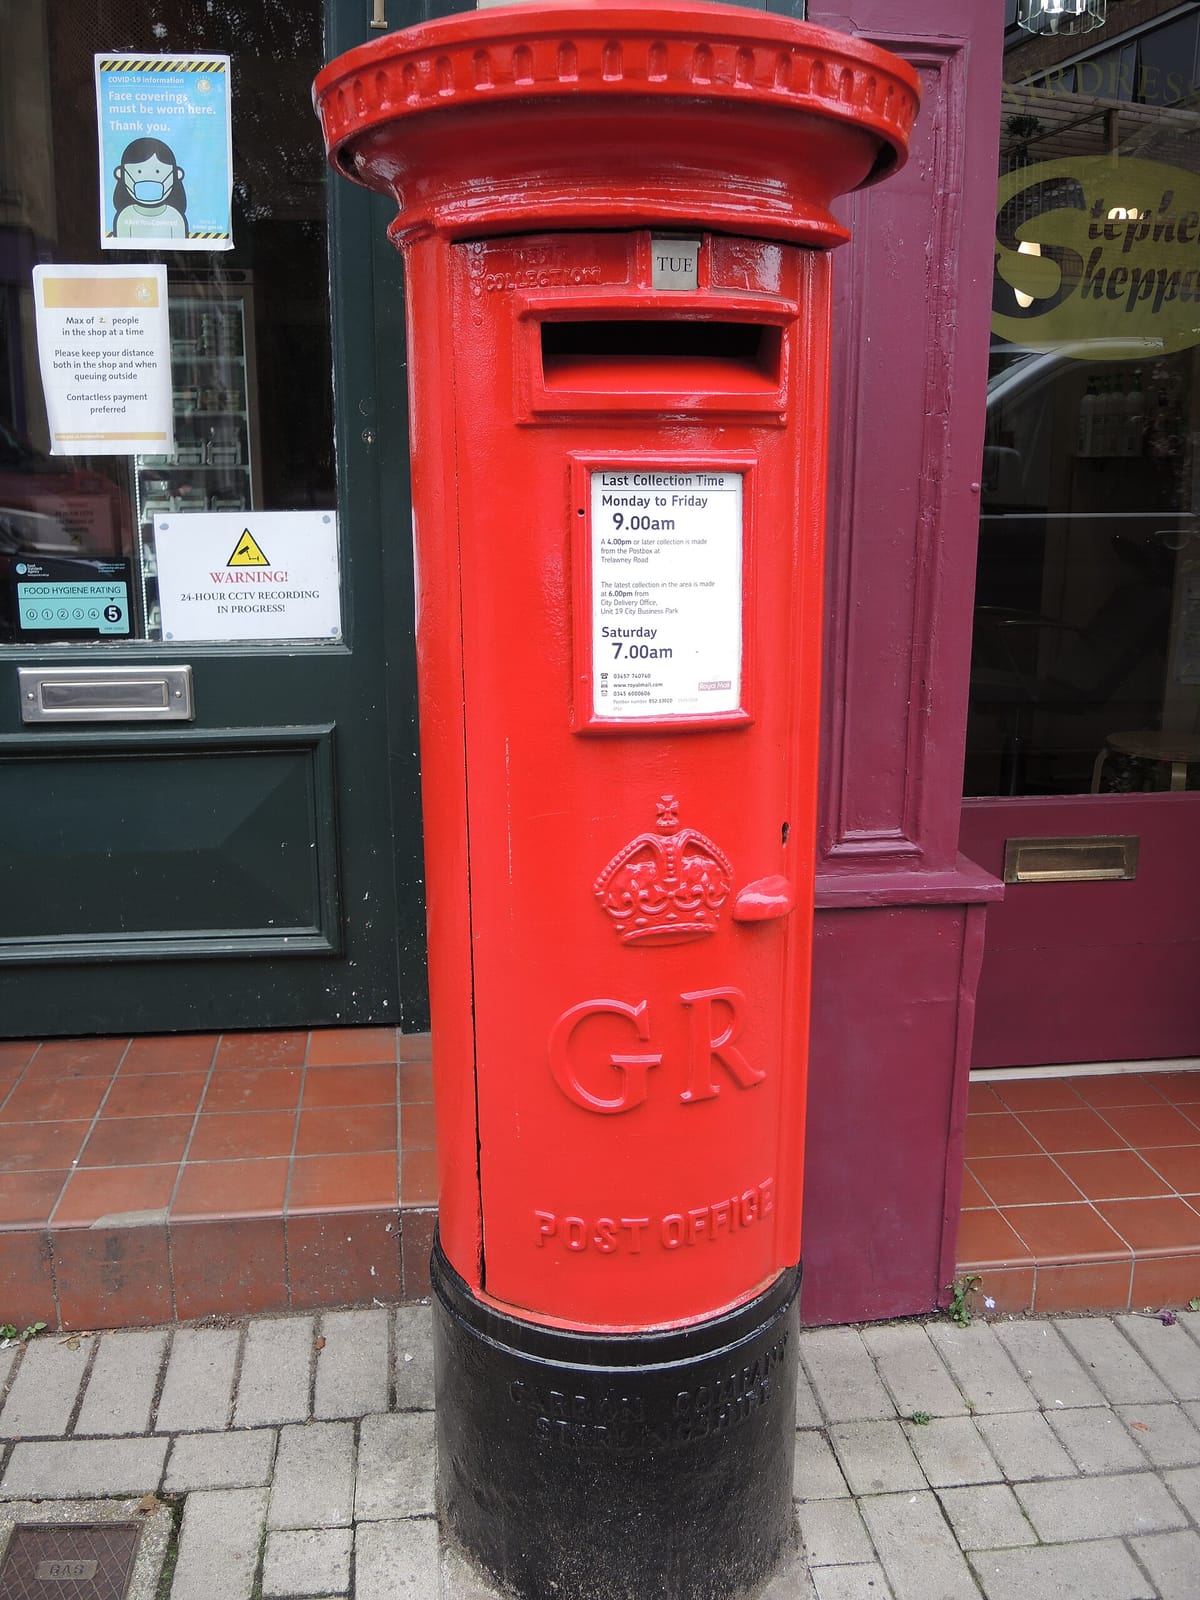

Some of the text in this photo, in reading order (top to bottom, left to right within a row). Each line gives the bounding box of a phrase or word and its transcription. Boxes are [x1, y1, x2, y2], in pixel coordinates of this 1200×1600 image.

[108, 76, 141, 84] COVID-19
[109, 91, 188, 104] Face coverings
[109, 104, 216, 115] must be worn here.
[109, 120, 171, 134] Thank you.
[656, 256, 693, 273] TUE
[66, 317, 84, 325] Max
[86, 316, 94, 325] of
[112, 317, 139, 327] people
[62, 328, 70, 336] in
[72, 328, 86, 336] the
[87, 328, 107, 338] shop
[125, 328, 144, 336] time
[54, 349, 154, 359] Please keep your distance
[53, 361, 157, 371] both in the shop and when
[74, 372, 138, 382] queuing outside
[66, 393, 148, 404] Contactless payment
[90, 405, 126, 415] preferred
[602, 474, 725, 487] Last Collection Time
[602, 495, 708, 508] Monday to Friday
[612, 513, 675, 530] 9.00am
[209, 571, 289, 584] WARNING!
[24, 586, 121, 595] FOOD HYGIENE RATING
[181, 590, 320, 601] 24-HOUR CCTV RECORDING
[608, 590, 633, 598] 6.00pm
[601, 599, 612, 607] City
[613, 599, 638, 607] Delivery
[108, 607, 118, 621] 5
[217, 604, 286, 614] IN PROGRESS!
[624, 608, 636, 616] City
[602, 626, 657, 639] Saturday
[612, 642, 673, 659] 7.00am
[535, 1177, 773, 1254] POST OFFICE
